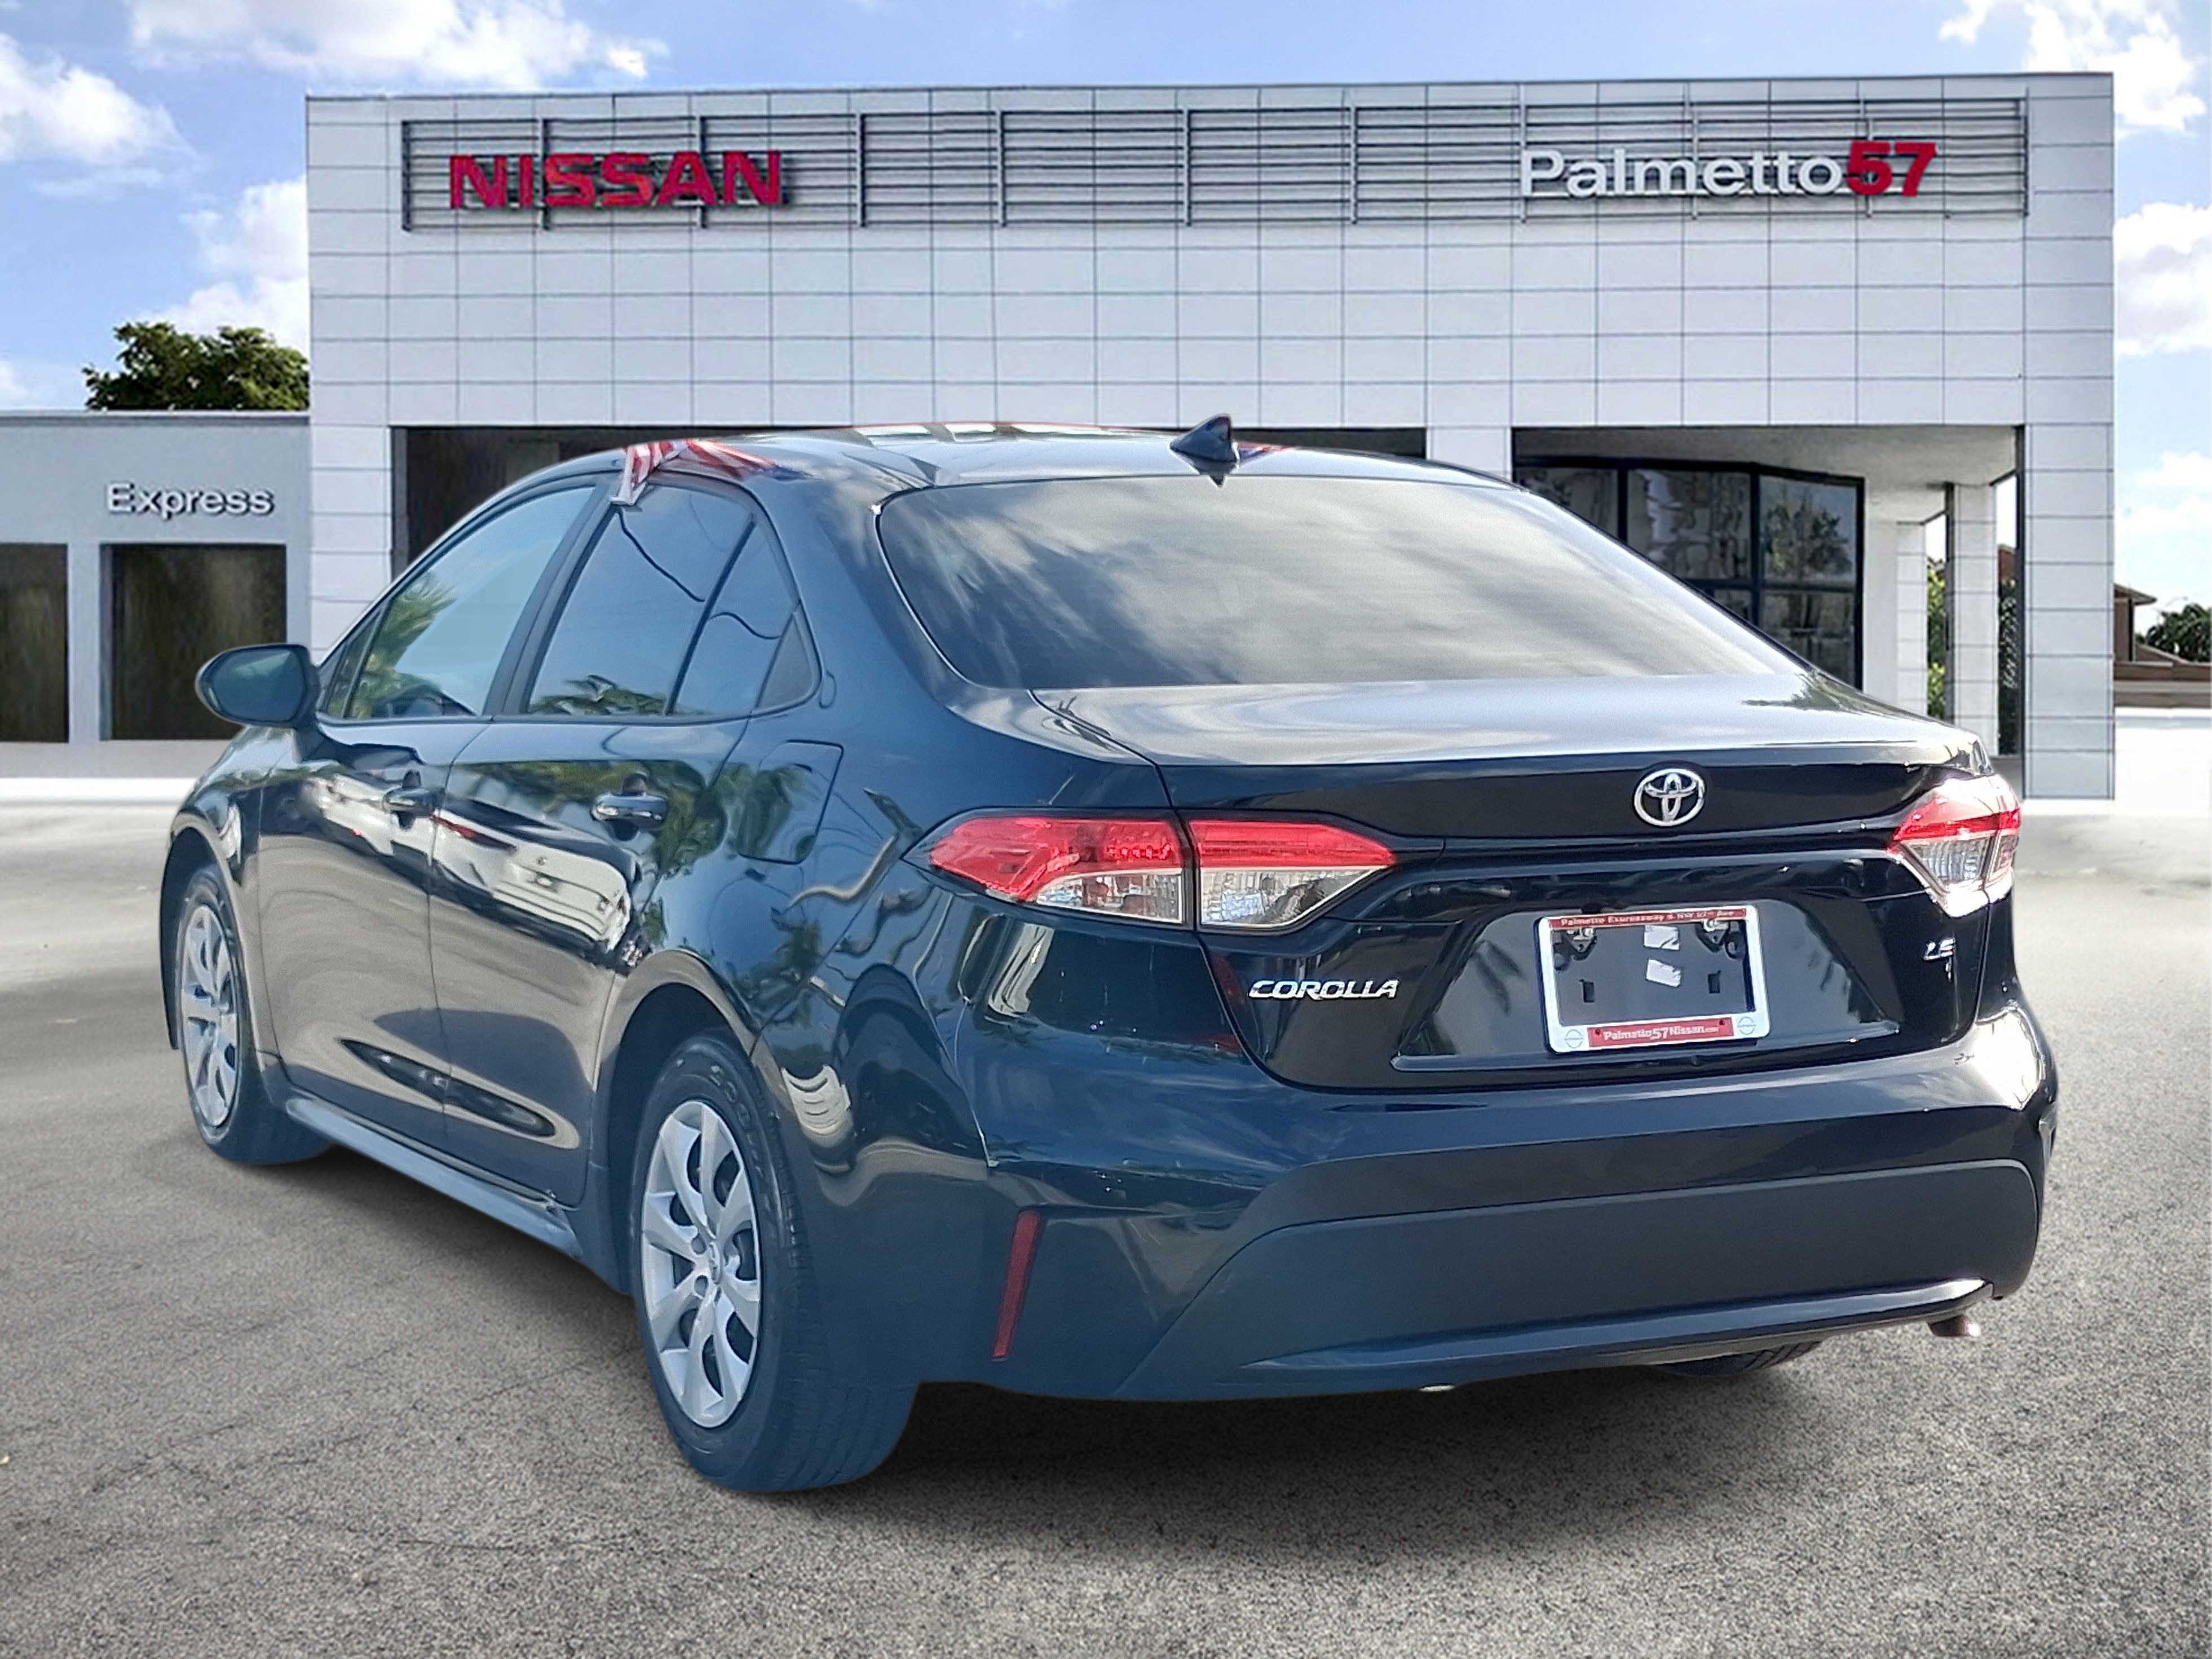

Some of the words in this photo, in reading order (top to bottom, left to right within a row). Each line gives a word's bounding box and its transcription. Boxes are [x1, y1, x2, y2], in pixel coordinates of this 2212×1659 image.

[450, 149, 782, 209] NISSAN
[1520, 140, 1937, 197] Palmetto57
[108, 483, 273, 520] Express
[1248, 979, 1400, 1000] COROLLA
